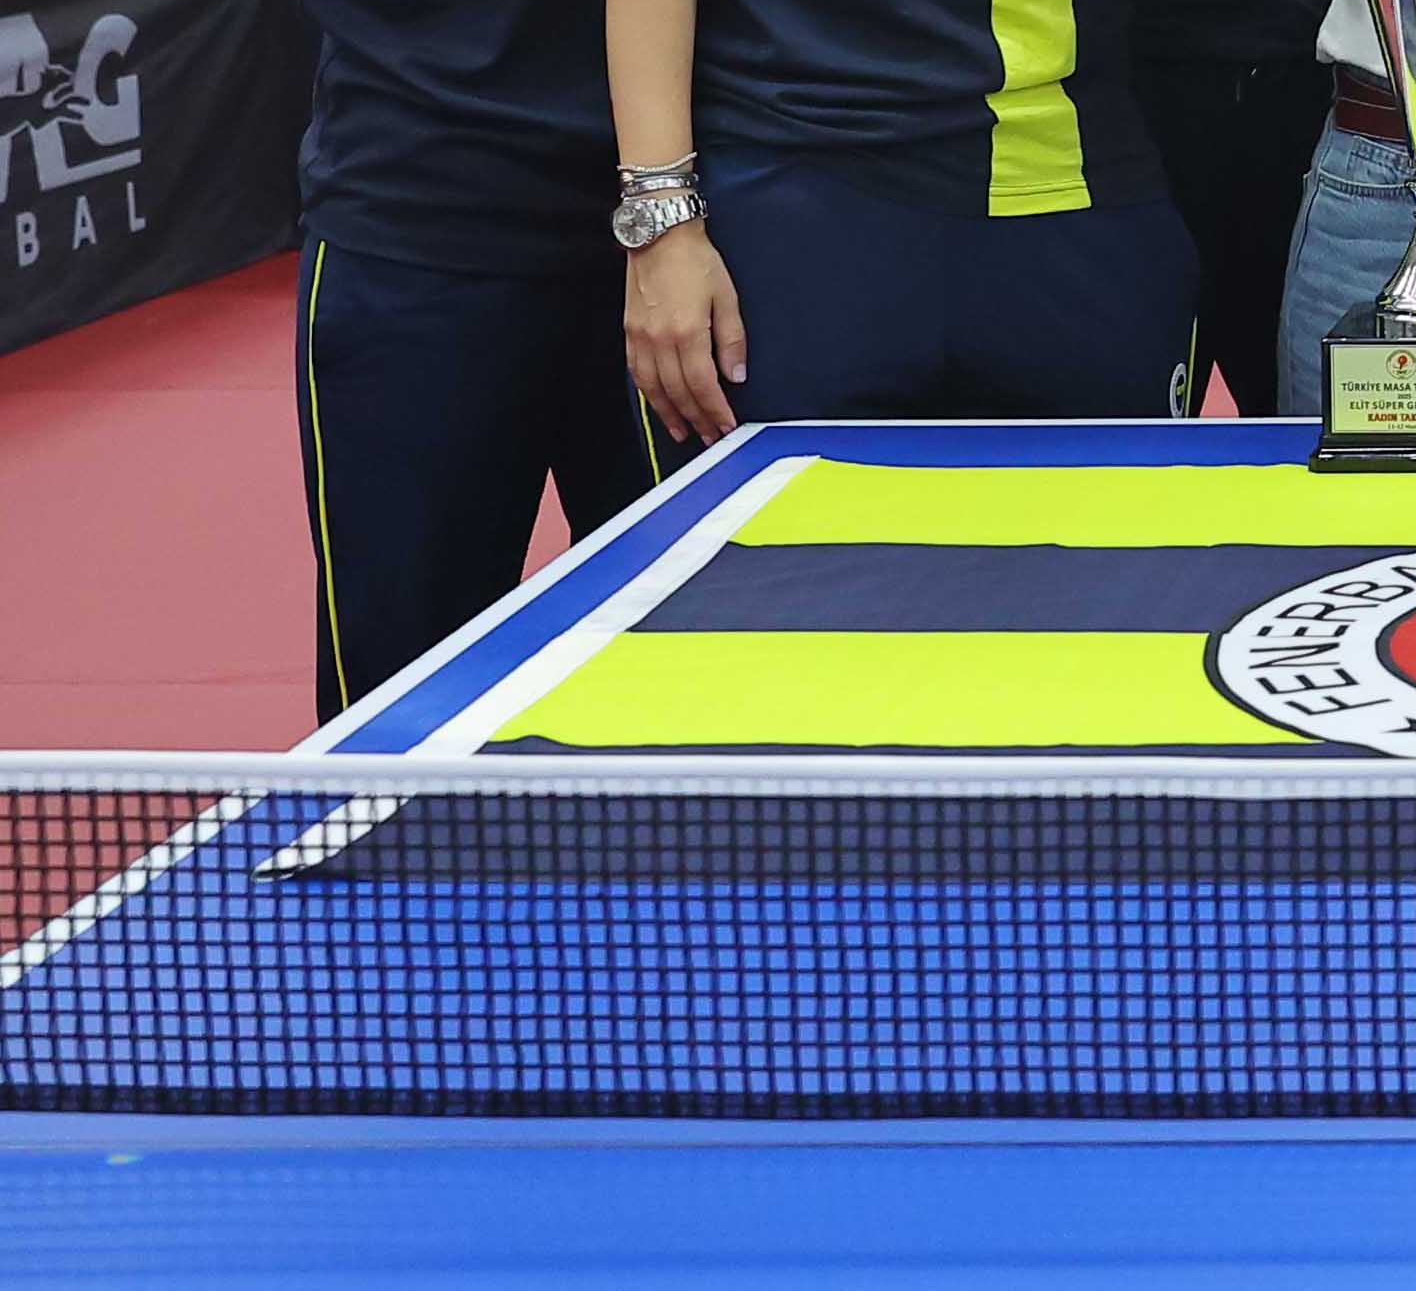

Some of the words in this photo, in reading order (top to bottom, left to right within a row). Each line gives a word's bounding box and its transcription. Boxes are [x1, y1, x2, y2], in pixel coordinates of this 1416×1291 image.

[1341, 381, 1381, 392] TÜRKİYE
[1384, 382, 1411, 392] MASA
[1350, 400, 1370, 410] ELİT
[1372, 399, 1405, 410] SÜPER
[1367, 413, 1397, 422] KADIN
